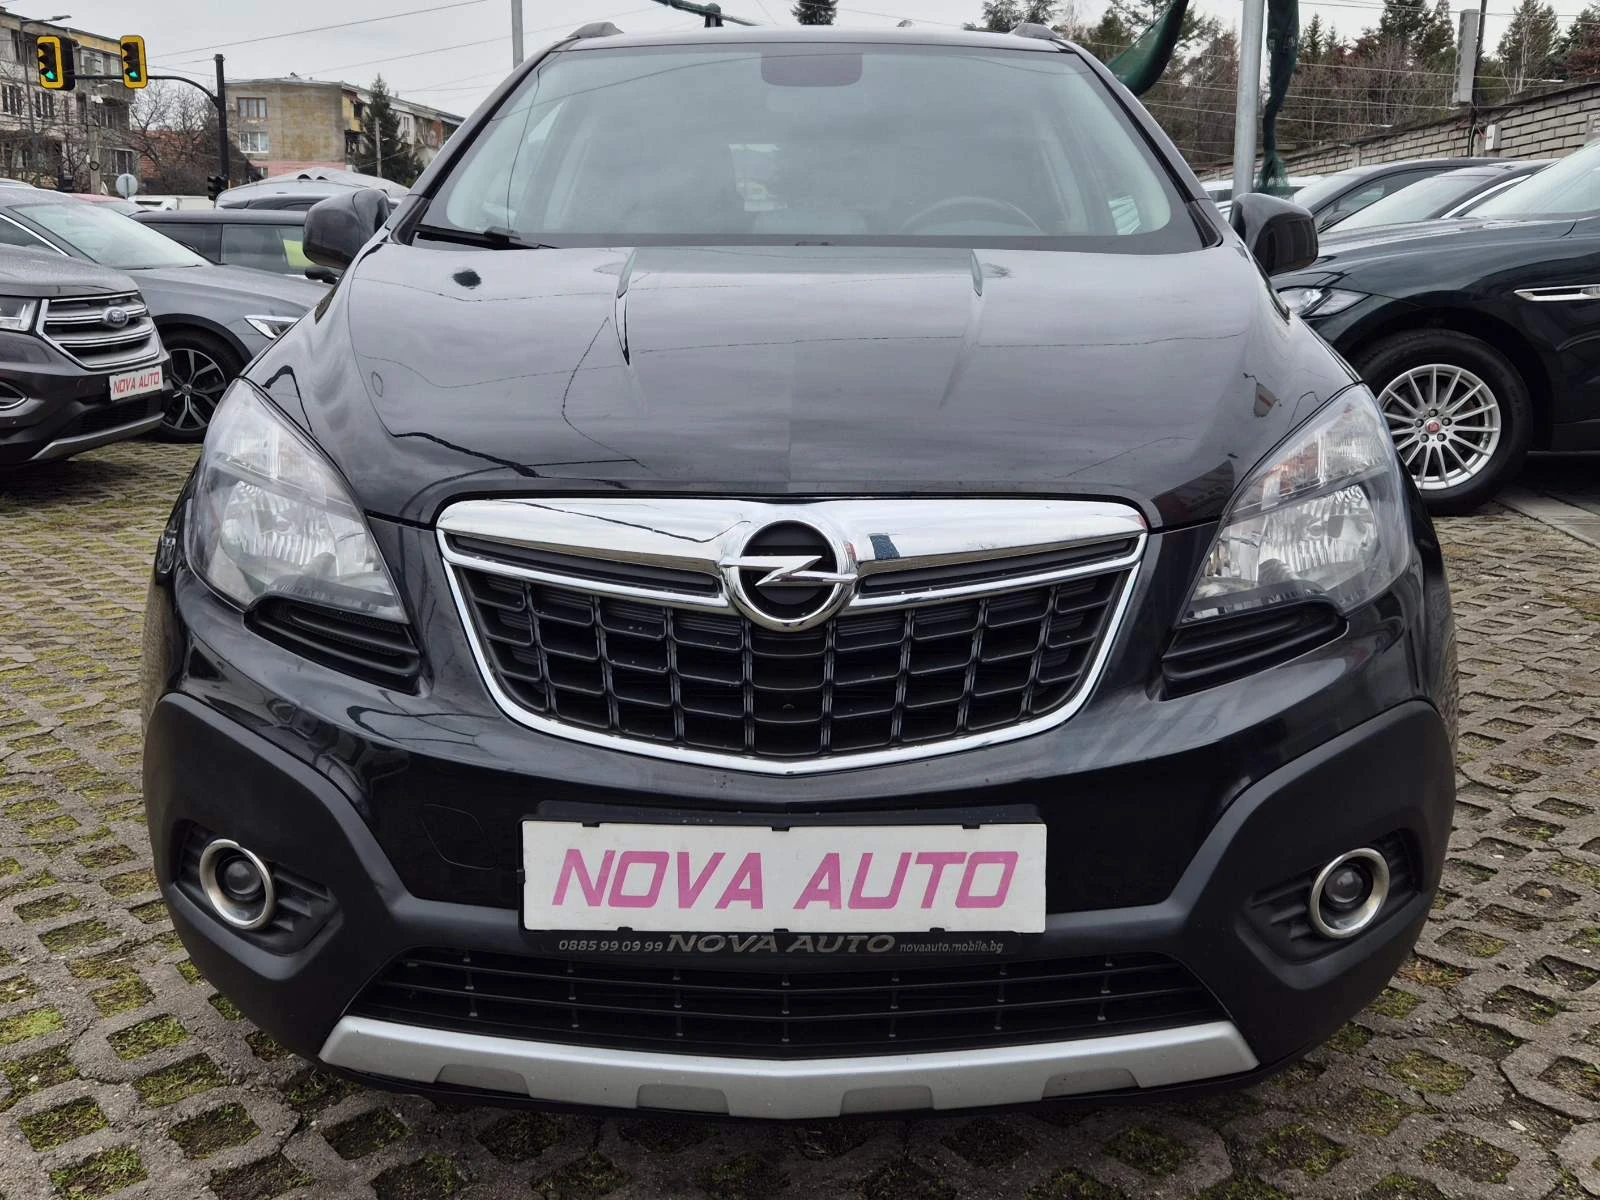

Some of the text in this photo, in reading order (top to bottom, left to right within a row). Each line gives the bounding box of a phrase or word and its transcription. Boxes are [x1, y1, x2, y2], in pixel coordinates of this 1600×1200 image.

[113, 371, 160, 393] NOVA AUTO
[552, 848, 1020, 910] NOVA AUTO
[558, 940, 597, 951] 0885
[600, 941, 618, 952] 99
[622, 941, 641, 952] 09
[644, 942, 664, 952] 99
[667, 934, 778, 953] NOVA
[785, 934, 896, 953] AUTO
